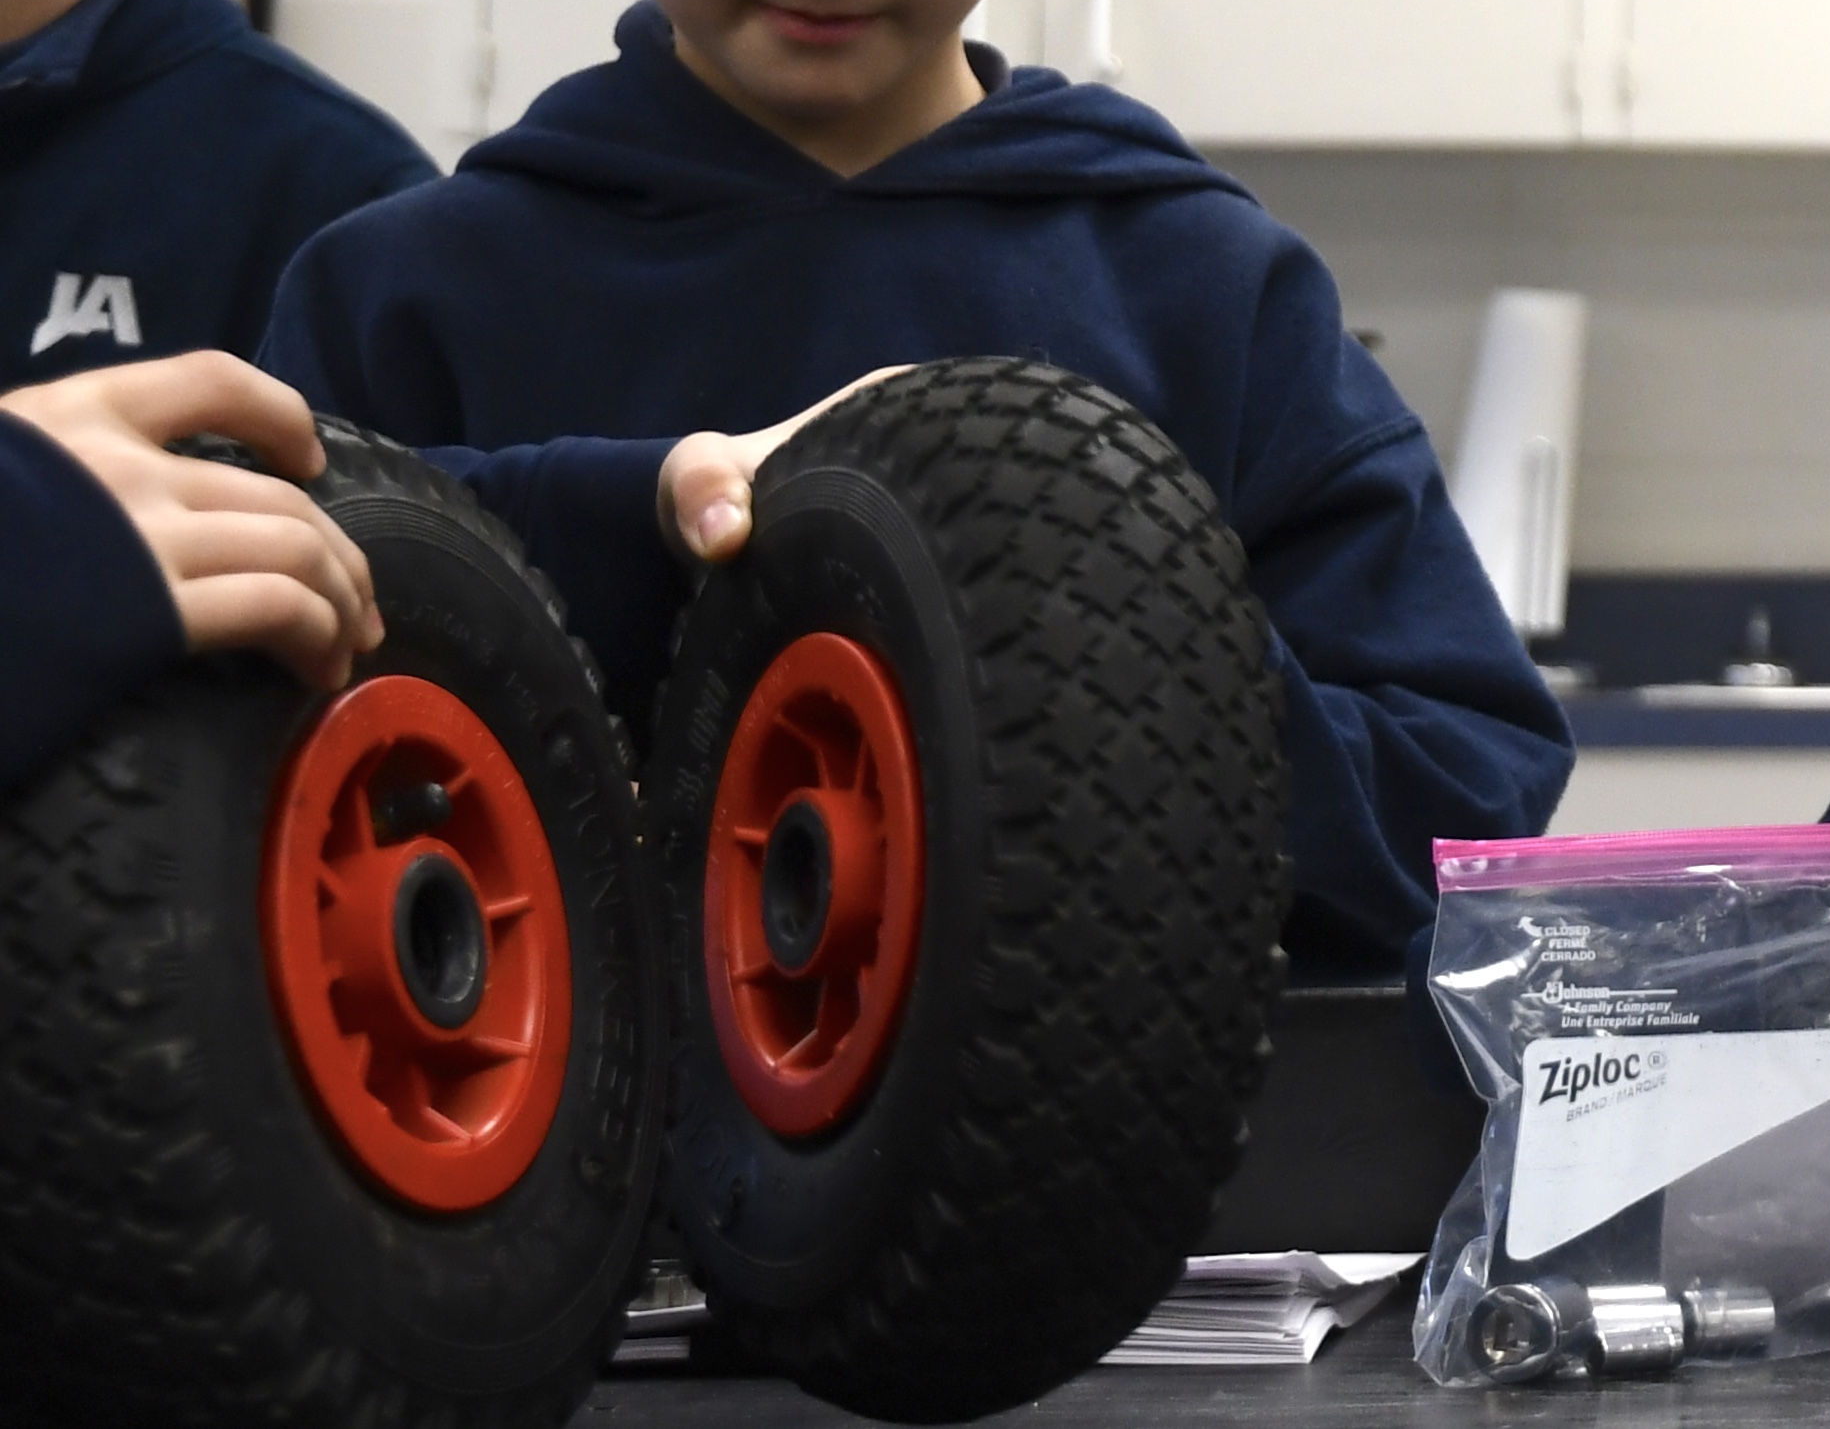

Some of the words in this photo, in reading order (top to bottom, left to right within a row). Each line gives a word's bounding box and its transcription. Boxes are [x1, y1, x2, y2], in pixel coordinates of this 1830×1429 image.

[30, 272, 142, 356] JA
[1544, 925, 1591, 938] CLOSED
[1541, 950, 1596, 961] CERRADO
[1574, 1001, 1614, 1016] Family
[1616, 1000, 1673, 1016] Company
[1561, 1015, 1584, 1028] Une
[1586, 1013, 1644, 1029] Entreprise
[1646, 1012, 1700, 1026] Familiale
[1538, 1052, 1641, 1106] Ziploc
